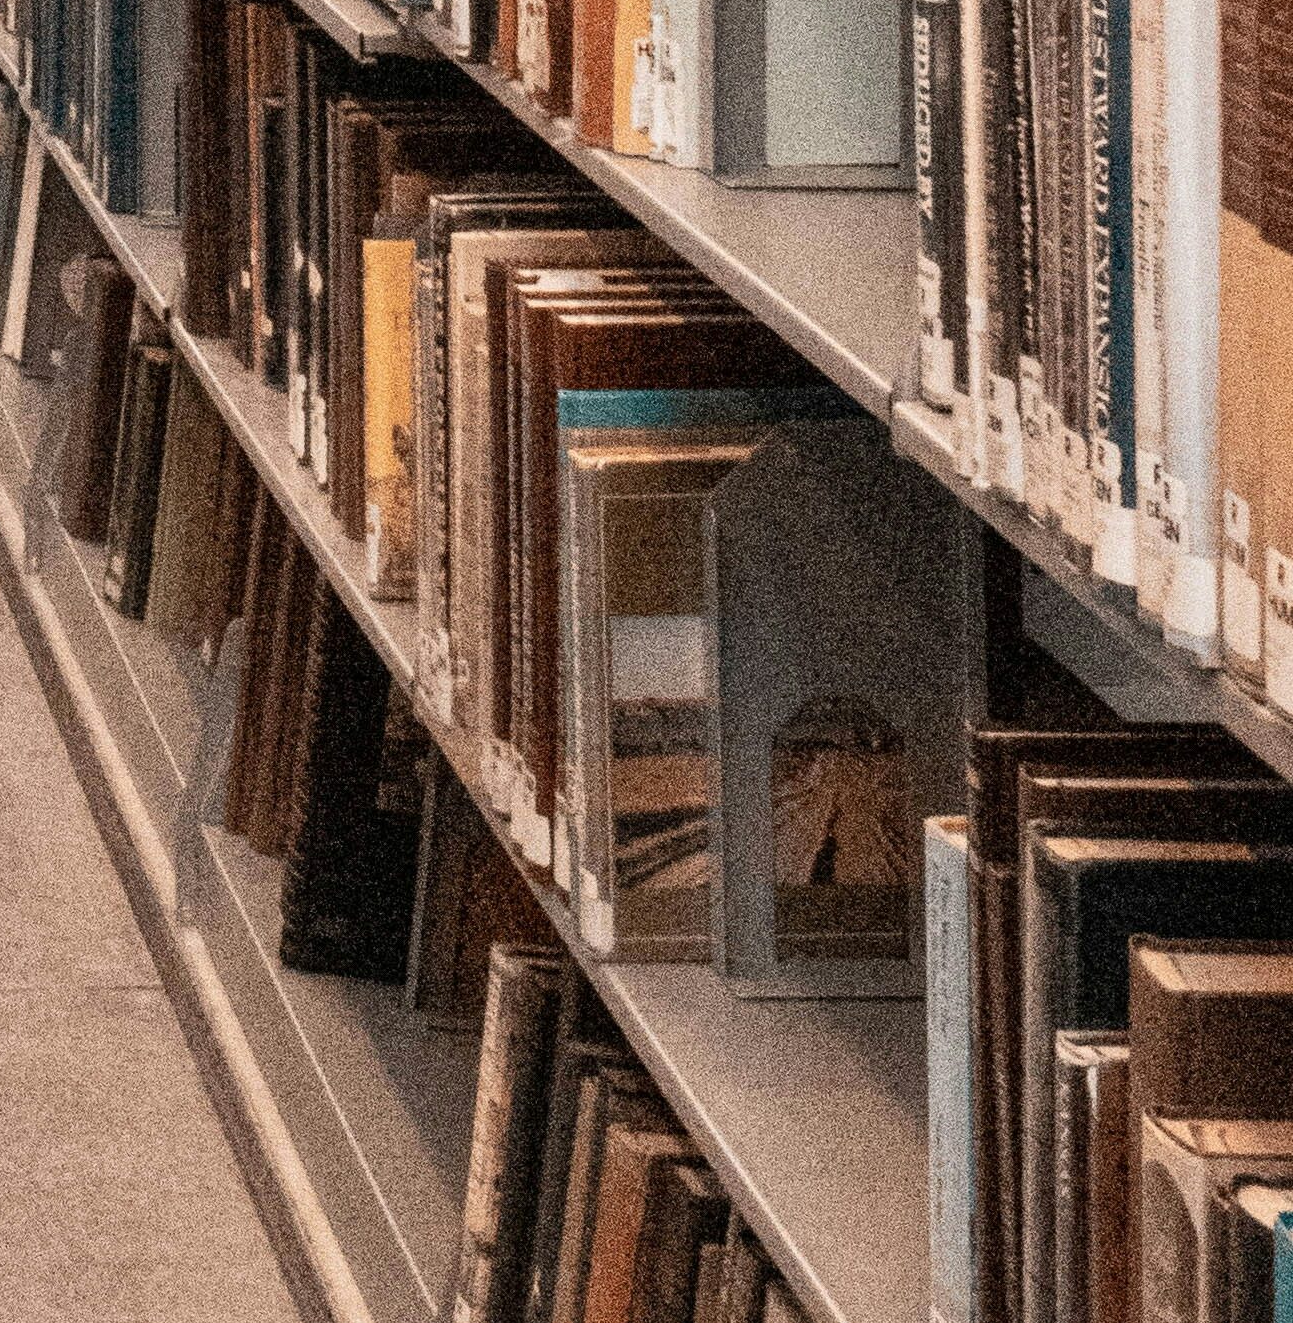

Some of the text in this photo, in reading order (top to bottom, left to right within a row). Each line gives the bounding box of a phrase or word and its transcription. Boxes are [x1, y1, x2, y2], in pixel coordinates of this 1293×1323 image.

[915, 15, 934, 220] SEDUCED BY
[1091, 222, 1110, 439] EXPANSIO
